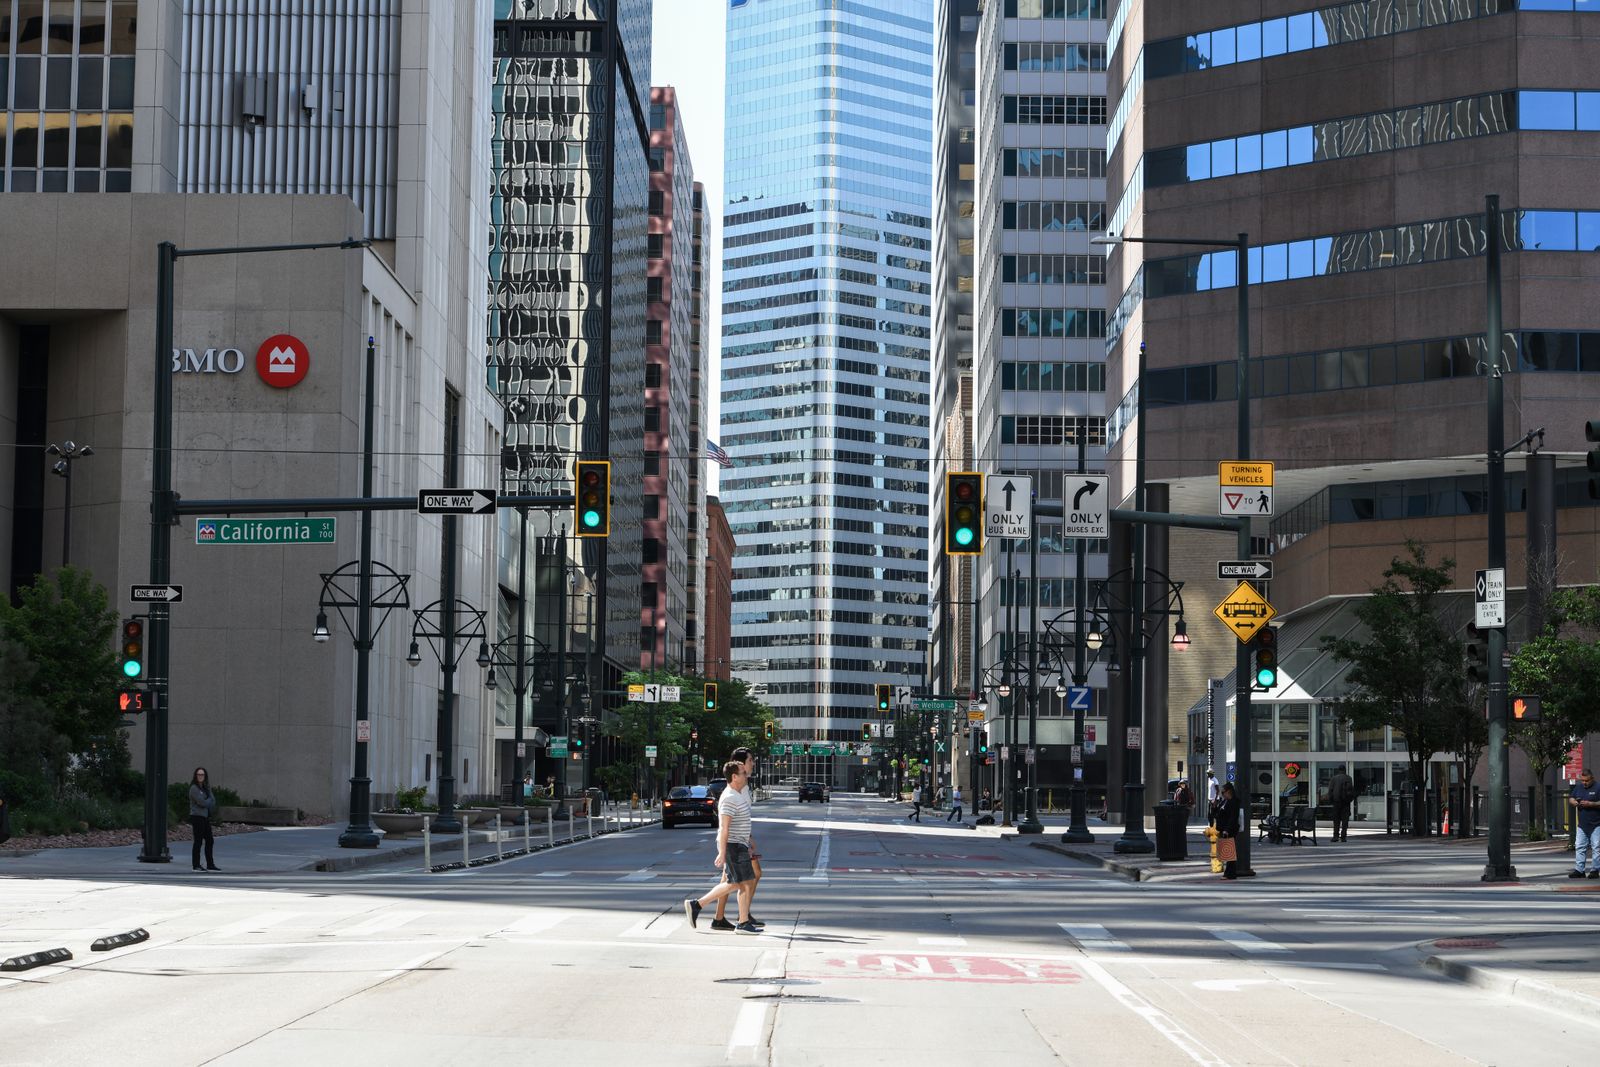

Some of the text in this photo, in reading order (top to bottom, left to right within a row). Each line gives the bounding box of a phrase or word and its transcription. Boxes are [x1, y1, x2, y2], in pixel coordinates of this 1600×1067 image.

[1231, 466, 1263, 474] TURNING
[1229, 475, 1264, 483] VEHICLES
[426, 496, 473, 507] ONE WAY
[1244, 497, 1254, 505] TO
[992, 513, 1024, 525] ONLY
[1070, 513, 1102, 524] ONLY
[220, 522, 310, 541] California
[321, 522, 330, 530] St
[319, 530, 333, 538] 700
[988, 526, 1027, 535] BUS LANE
[1488, 581, 1502, 589] TRAIN
[135, 694, 142, 709] 5
[1071, 687, 1088, 708] Z
[1207, 688, 1215, 766] DOMINION TOWERS
[937, 743, 944, 752] X
